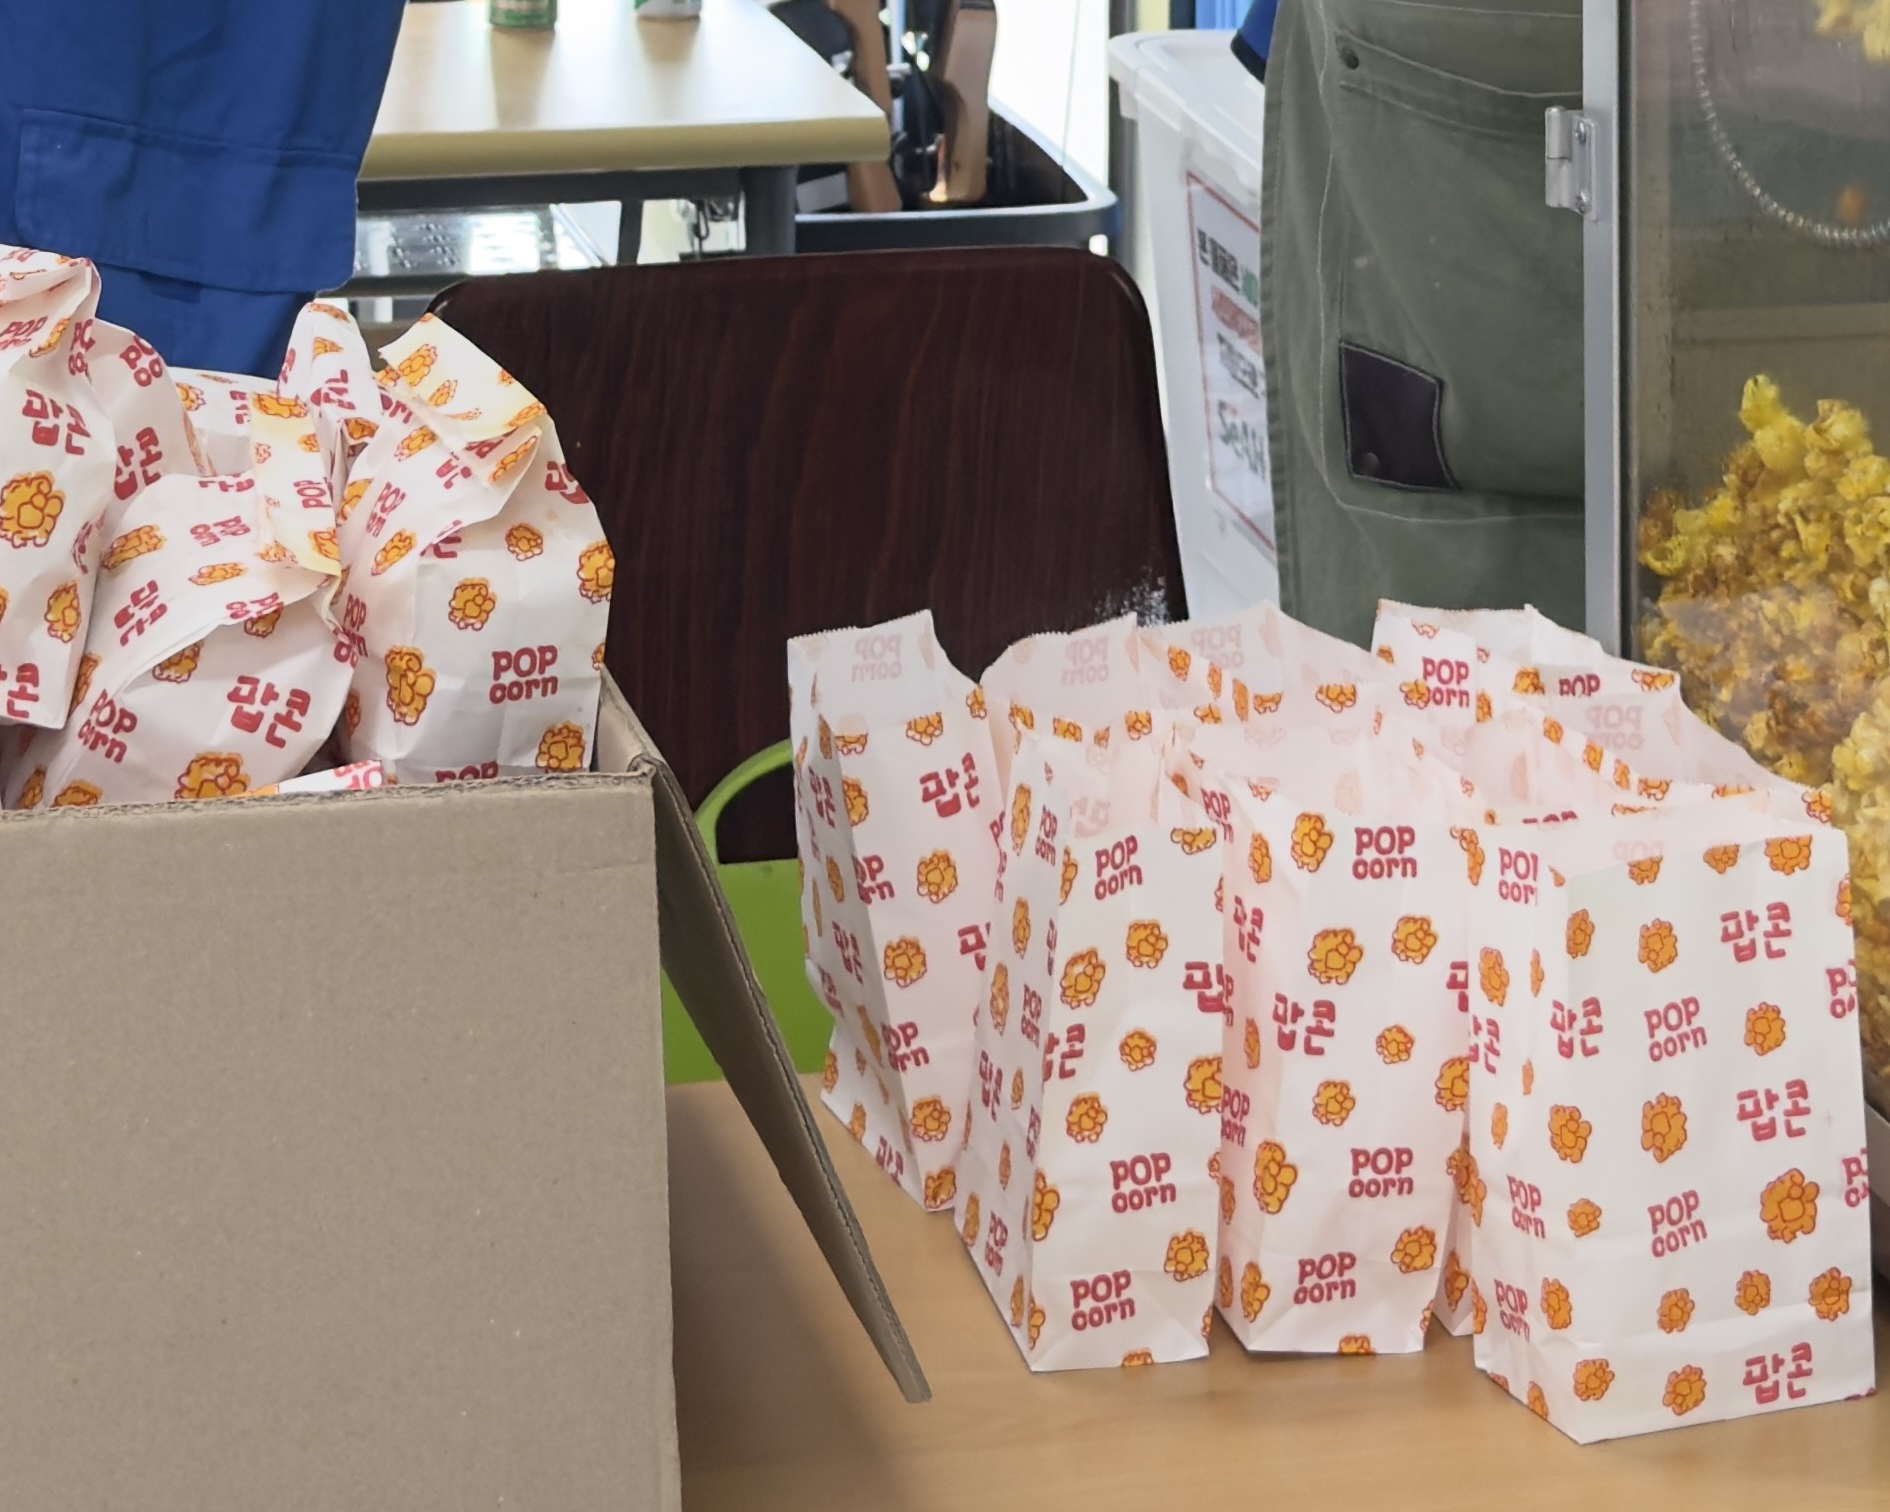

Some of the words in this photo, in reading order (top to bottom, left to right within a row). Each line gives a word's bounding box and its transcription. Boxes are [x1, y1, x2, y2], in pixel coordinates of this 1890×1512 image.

[22, 388, 92, 456] 팝콘
[492, 644, 558, 681] POP
[1422, 656, 1470, 687] POP
[489, 675, 559, 705] corn
[227, 675, 312, 749] 팝콘
[919, 752, 980, 818] 팝콘
[1200, 787, 1232, 821] POP
[1094, 835, 1139, 879] POP
[1354, 825, 1416, 856] POP
[1094, 864, 1144, 901] corn
[1351, 856, 1418, 881] corn
[1720, 902, 1793, 963] 팝콘
[1272, 992, 1337, 1057] 팝콘
[1549, 996, 1604, 1060] 팝콘
[1643, 995, 1701, 1038] POP
[1647, 1025, 1708, 1063] corn
[1221, 1084, 1251, 1123] POP
[1736, 1078, 1812, 1142] 팝콘
[1110, 1151, 1172, 1191] POP
[1350, 1146, 1414, 1177] POP
[1111, 1182, 1177, 1214] corn
[1348, 1175, 1414, 1199] corn
[1506, 1174, 1542, 1213] POP
[1511, 1203, 1546, 1240] corn
[1647, 1189, 1701, 1235] POP
[1650, 1217, 1708, 1259] corn
[1297, 1251, 1357, 1285] POP
[1070, 1268, 1132, 1309] POP
[1293, 1278, 1357, 1305] corn
[1494, 1278, 1529, 1317] POP
[1070, 1294, 1136, 1332] corn
[1742, 1341, 1814, 1405] 팝콘
